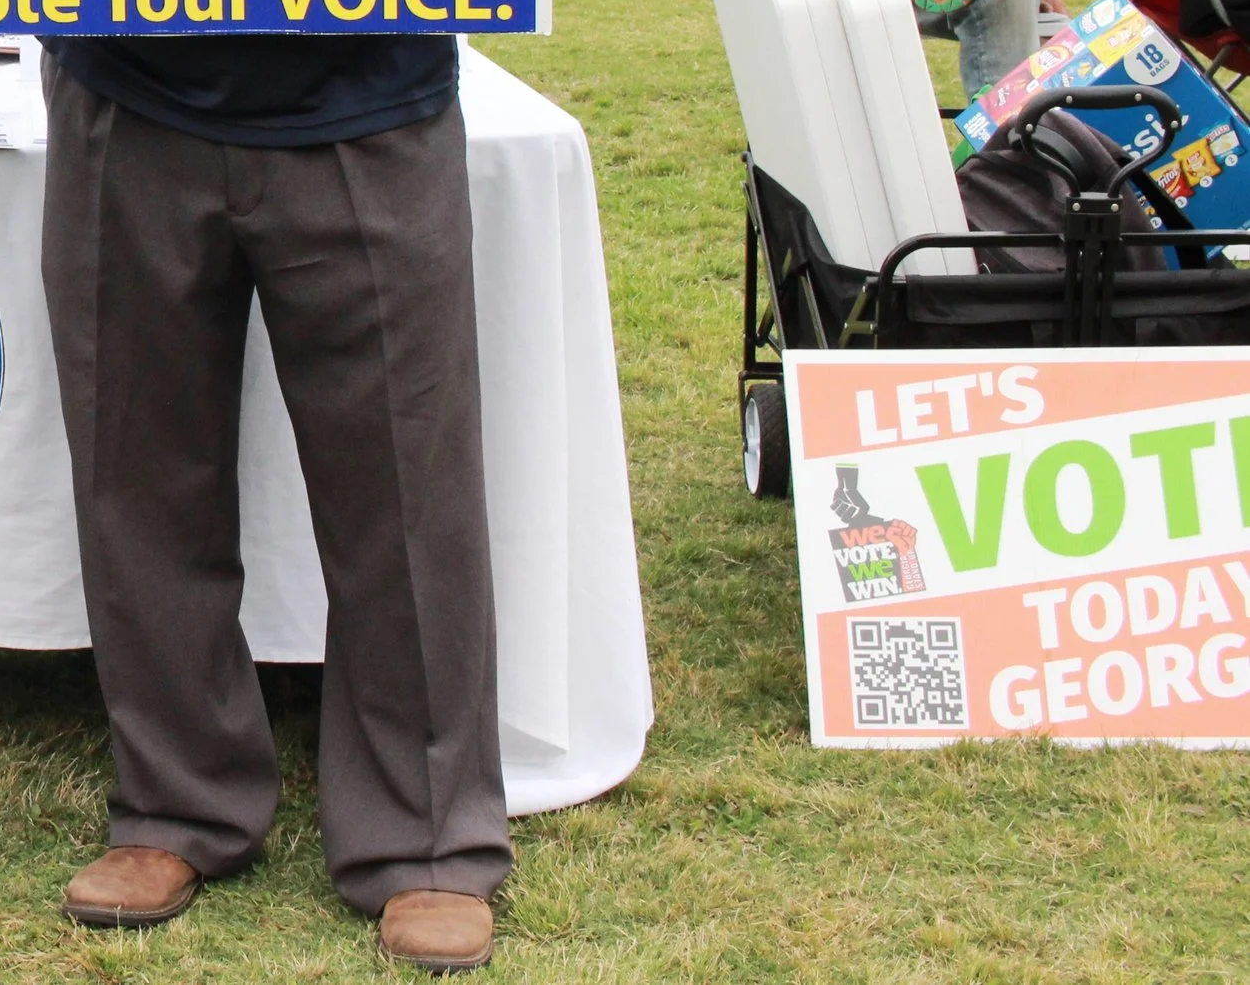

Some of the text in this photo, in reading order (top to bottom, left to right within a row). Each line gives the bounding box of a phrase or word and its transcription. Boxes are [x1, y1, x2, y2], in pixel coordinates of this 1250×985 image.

[1136, 43, 1164, 71] 18
[1149, 59, 1170, 78] BAGS
[855, 365, 1045, 447] LET'S
[840, 524, 886, 548] we
[848, 558, 894, 582] we
[847, 575, 902, 600] WIN.
